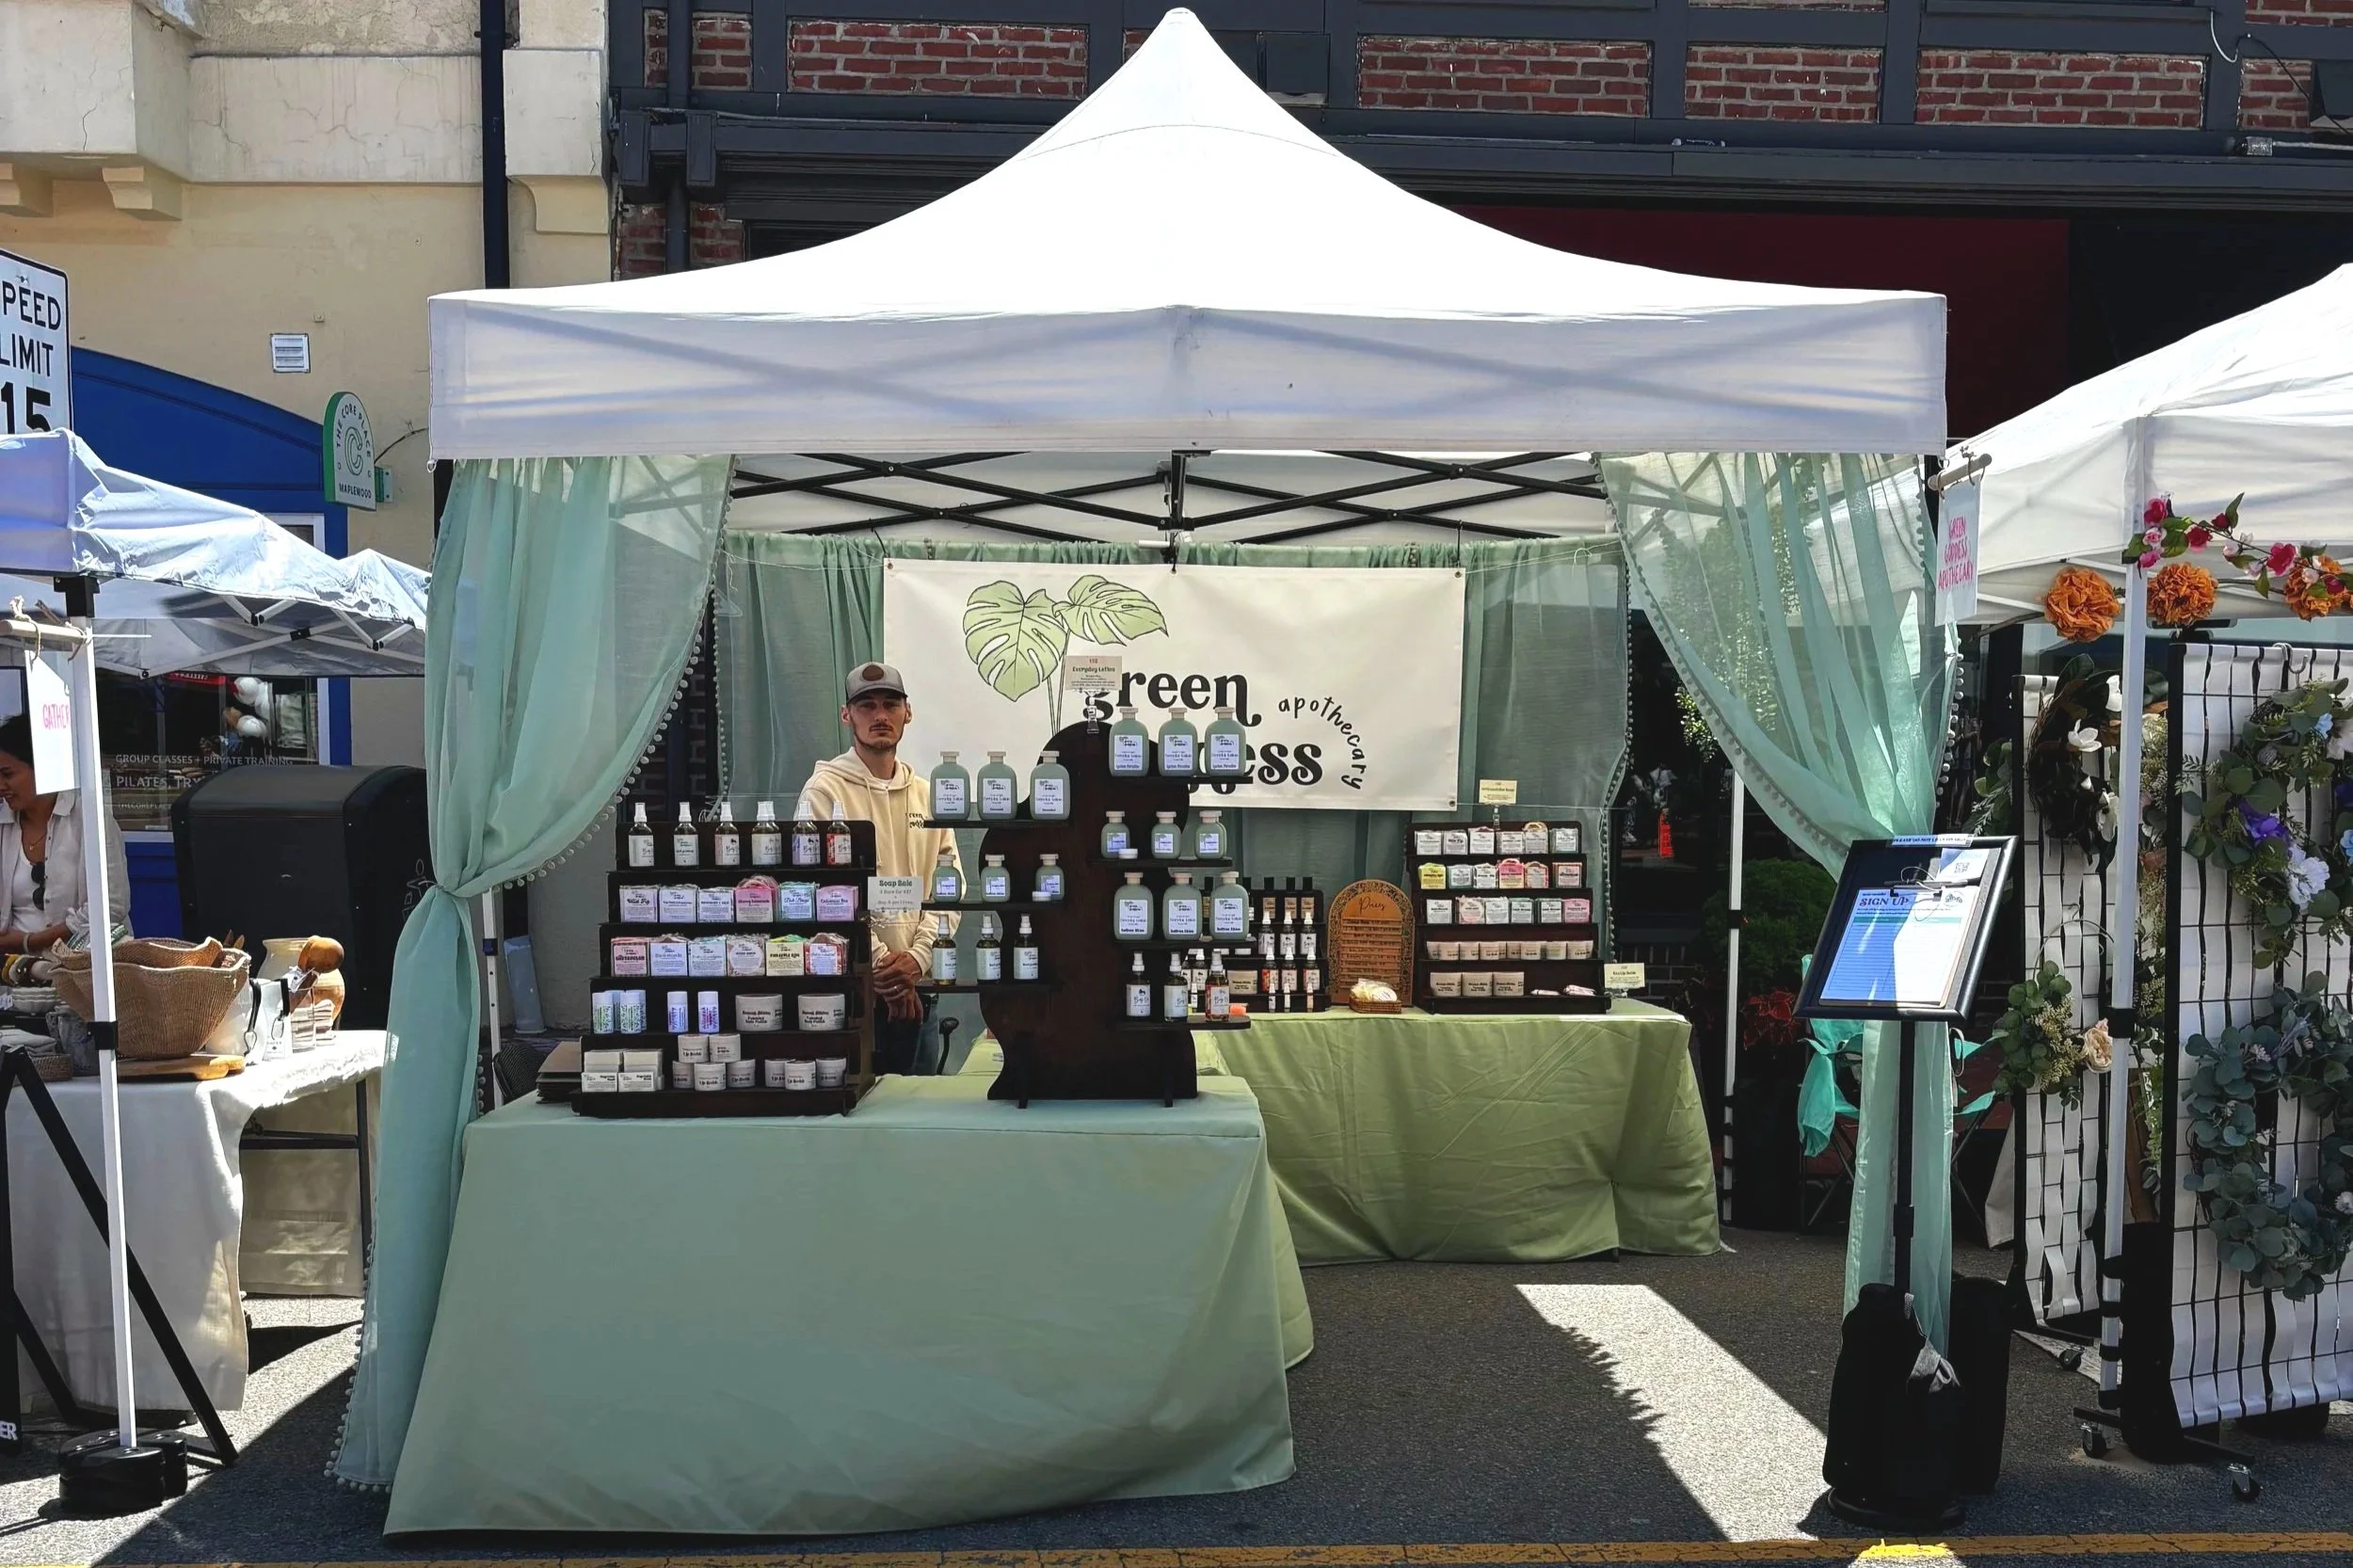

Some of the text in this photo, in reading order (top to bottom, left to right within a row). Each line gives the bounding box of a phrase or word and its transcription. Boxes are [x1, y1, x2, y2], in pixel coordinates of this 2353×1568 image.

[2, 280, 61, 330] PEED
[0, 381, 51, 435] 15
[341, 403, 357, 419] CORE
[358, 412, 372, 458] PLACE
[339, 483, 372, 499] MAPLEWOOD
[1948, 515, 1966, 540] GREEN
[1938, 560, 1974, 591] APOTHECARY
[1277, 695, 1367, 791] apothecary
[115, 754, 150, 764] GROUP
[152, 755, 193, 764] CLASSES
[203, 756, 243, 765] PRIVATE
[247, 757, 294, 766] TRAINING
[879, 879, 896, 888] Soap
[1860, 896, 1909, 906] SIGN UP
[0, 1420, 19, 1440] ER
